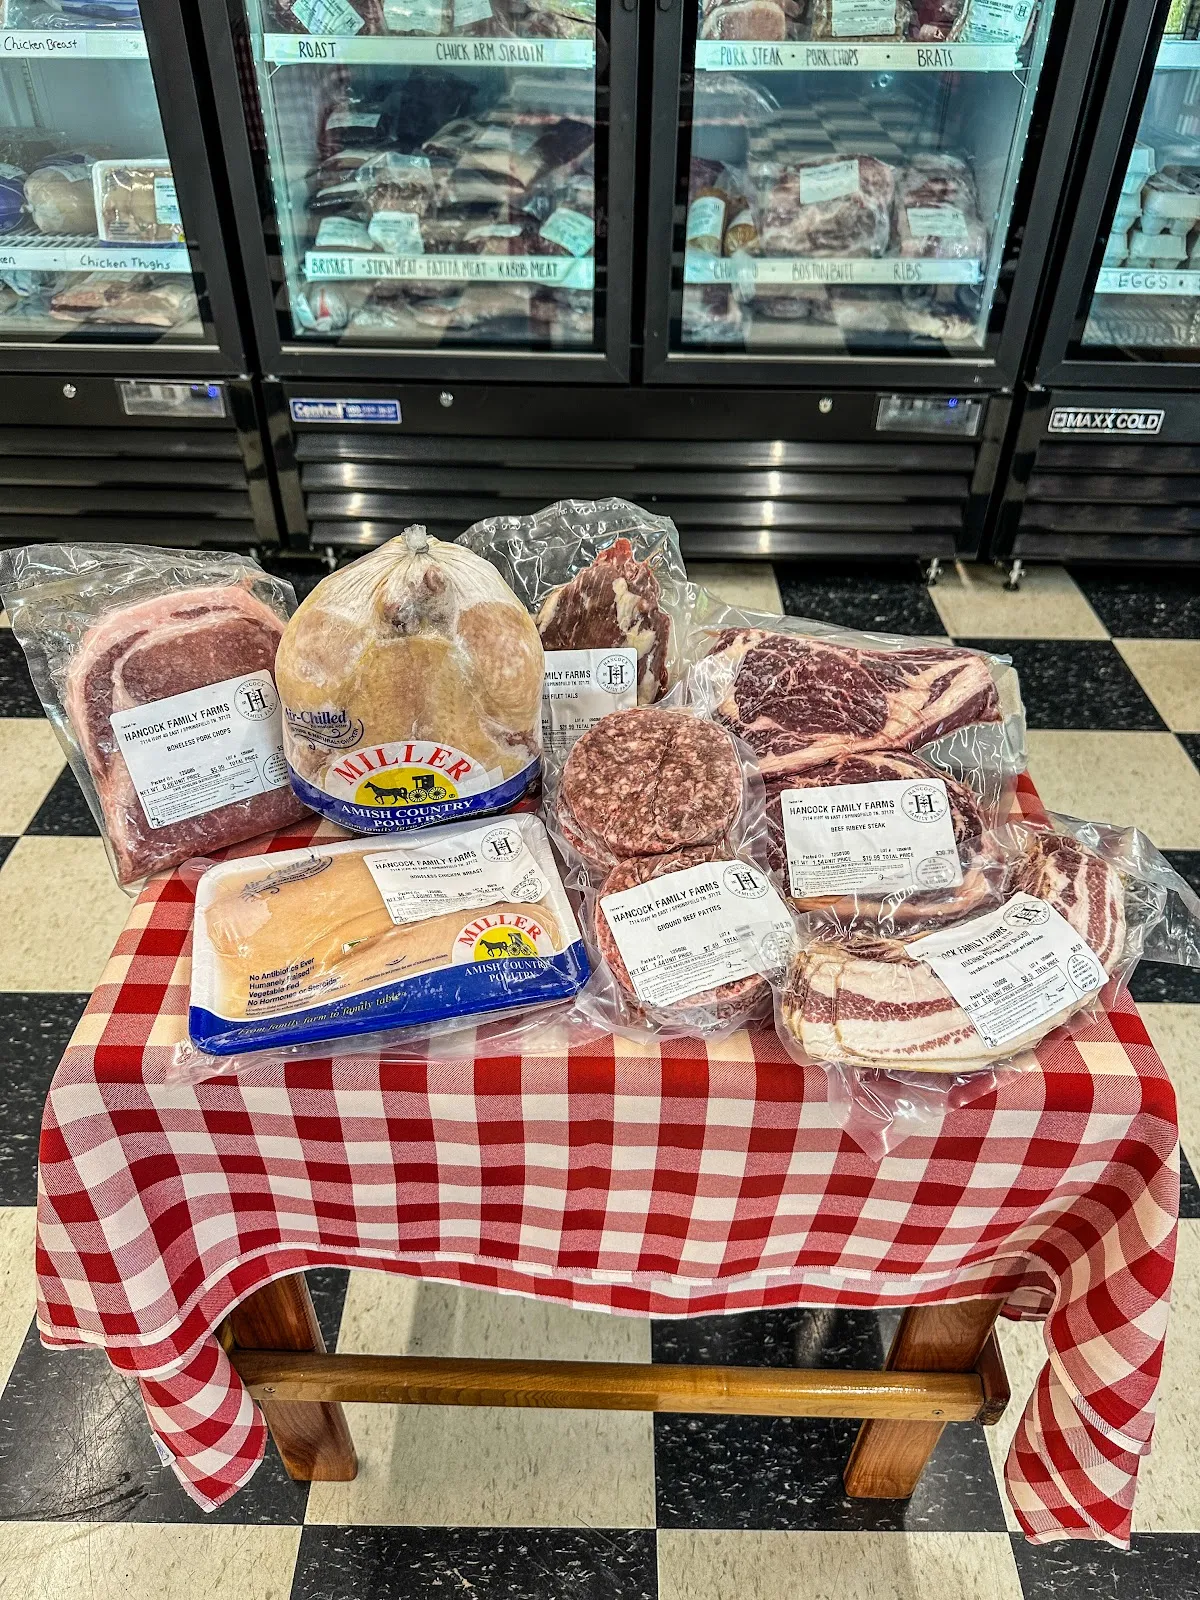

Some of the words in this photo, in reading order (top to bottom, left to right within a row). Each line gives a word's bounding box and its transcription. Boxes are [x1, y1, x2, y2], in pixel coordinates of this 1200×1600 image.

[4, 36, 45, 50] Chicken
[46, 38, 77, 50] Breast
[298, 41, 337, 58] ROAST
[436, 42, 468, 60] CHUCK
[473, 43, 495, 60] ARM
[499, 43, 544, 62] SIRLOIN
[720, 48, 748, 66] PORK
[752, 47, 783, 66] STEAK
[917, 49, 953, 67] BRATS
[80, 254, 127, 269] Chicken
[131, 257, 171, 270] Thighs
[311, 258, 354, 274] BRISKET
[530, 261, 558, 277] MEAT
[893, 264, 922, 281] RIBS
[1118, 271, 1168, 289] EGGS
[1066, 412, 1115, 428] MAXX
[1116, 413, 1159, 429] COLD
[544, 671, 563, 680] MILY
[565, 669, 591, 680] FARMS
[124, 722, 166, 742] HANCOCK
[166, 711, 198, 729] FAMILY
[199, 702, 230, 719] FARMS
[166, 738, 196, 752] BONELESS
[196, 731, 212, 743] PORK
[212, 727, 232, 738] CHOPS
[333, 744, 472, 786] MILLER
[341, 804, 393, 819] AMISH
[395, 798, 474, 818] COUNTRY
[790, 805, 829, 815] HANCOCK
[831, 802, 862, 813] FAMILY
[864, 799, 895, 810] FARMS
[373, 813, 446, 828] POULTRY
[830, 825, 845, 833] BEEF
[845, 823, 866, 832] RIBEYE
[375, 860, 415, 870] HANCOCK
[416, 858, 447, 866] FAMILY
[448, 850, 477, 864] FARMS
[613, 903, 654, 923] HANCOCK
[655, 890, 687, 909] FAMILY
[688, 880, 720, 897] FARMS
[657, 918, 682, 932] GROUND
[682, 912, 697, 923] BEEF
[698, 904, 722, 917] PATTIES
[457, 914, 542, 948] MILLER
[723, 935, 739, 944] TOTAL
[956, 937, 984, 955] FAMILY
[300, 957, 315, 968] Ever
[464, 961, 501, 977] AMISH
[248, 987, 285, 999] Vegetable
[286, 981, 300, 990] Fed
[249, 980, 285, 990] Humanely
[268, 1019, 301, 1032] family
[302, 1013, 328, 1025] farm
[329, 1009, 340, 1018] to
[342, 1001, 374, 1016] family
[375, 992, 400, 1006] table
